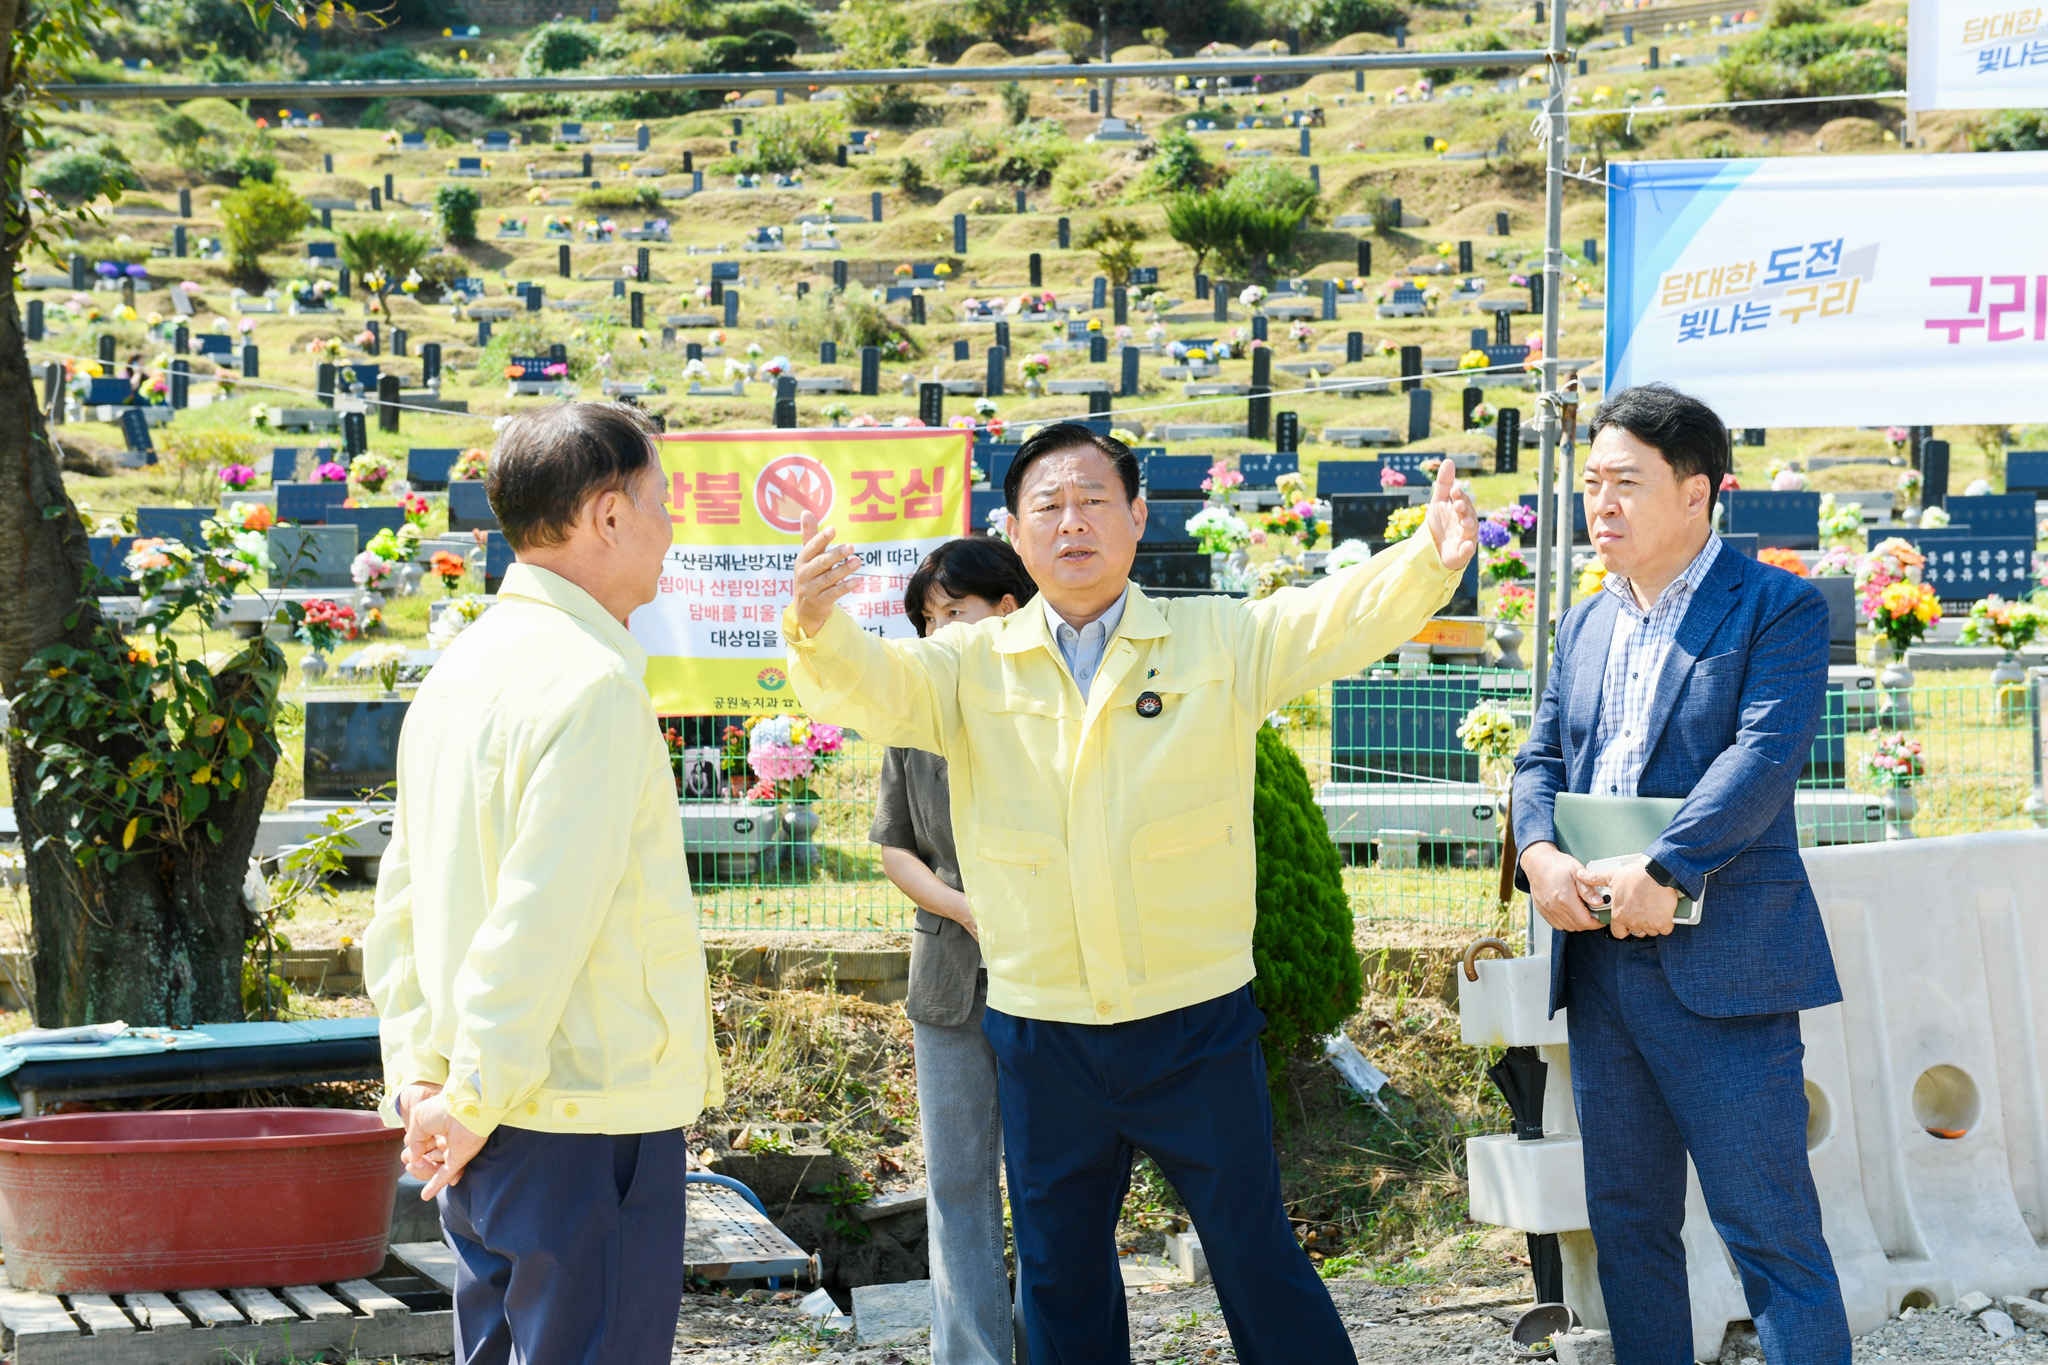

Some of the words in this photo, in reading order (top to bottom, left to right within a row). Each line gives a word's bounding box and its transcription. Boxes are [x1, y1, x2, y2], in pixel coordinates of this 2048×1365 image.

[1962, 7, 2043, 44] 담대한
[1660, 260, 1758, 307] 담대한
[1763, 237, 1845, 285] 도전
[1677, 301, 1772, 343] 빛나는
[1779, 278, 1861, 325] 구리
[848, 465, 945, 523] 조심
[887, 547, 920, 566] 따라
[658, 576, 705, 597] 림이나
[689, 604, 737, 622] 담배를
[742, 604, 776, 623] 피울
[710, 630, 779, 648] 대상임을
[713, 697, 778, 710] 공원녹지과
